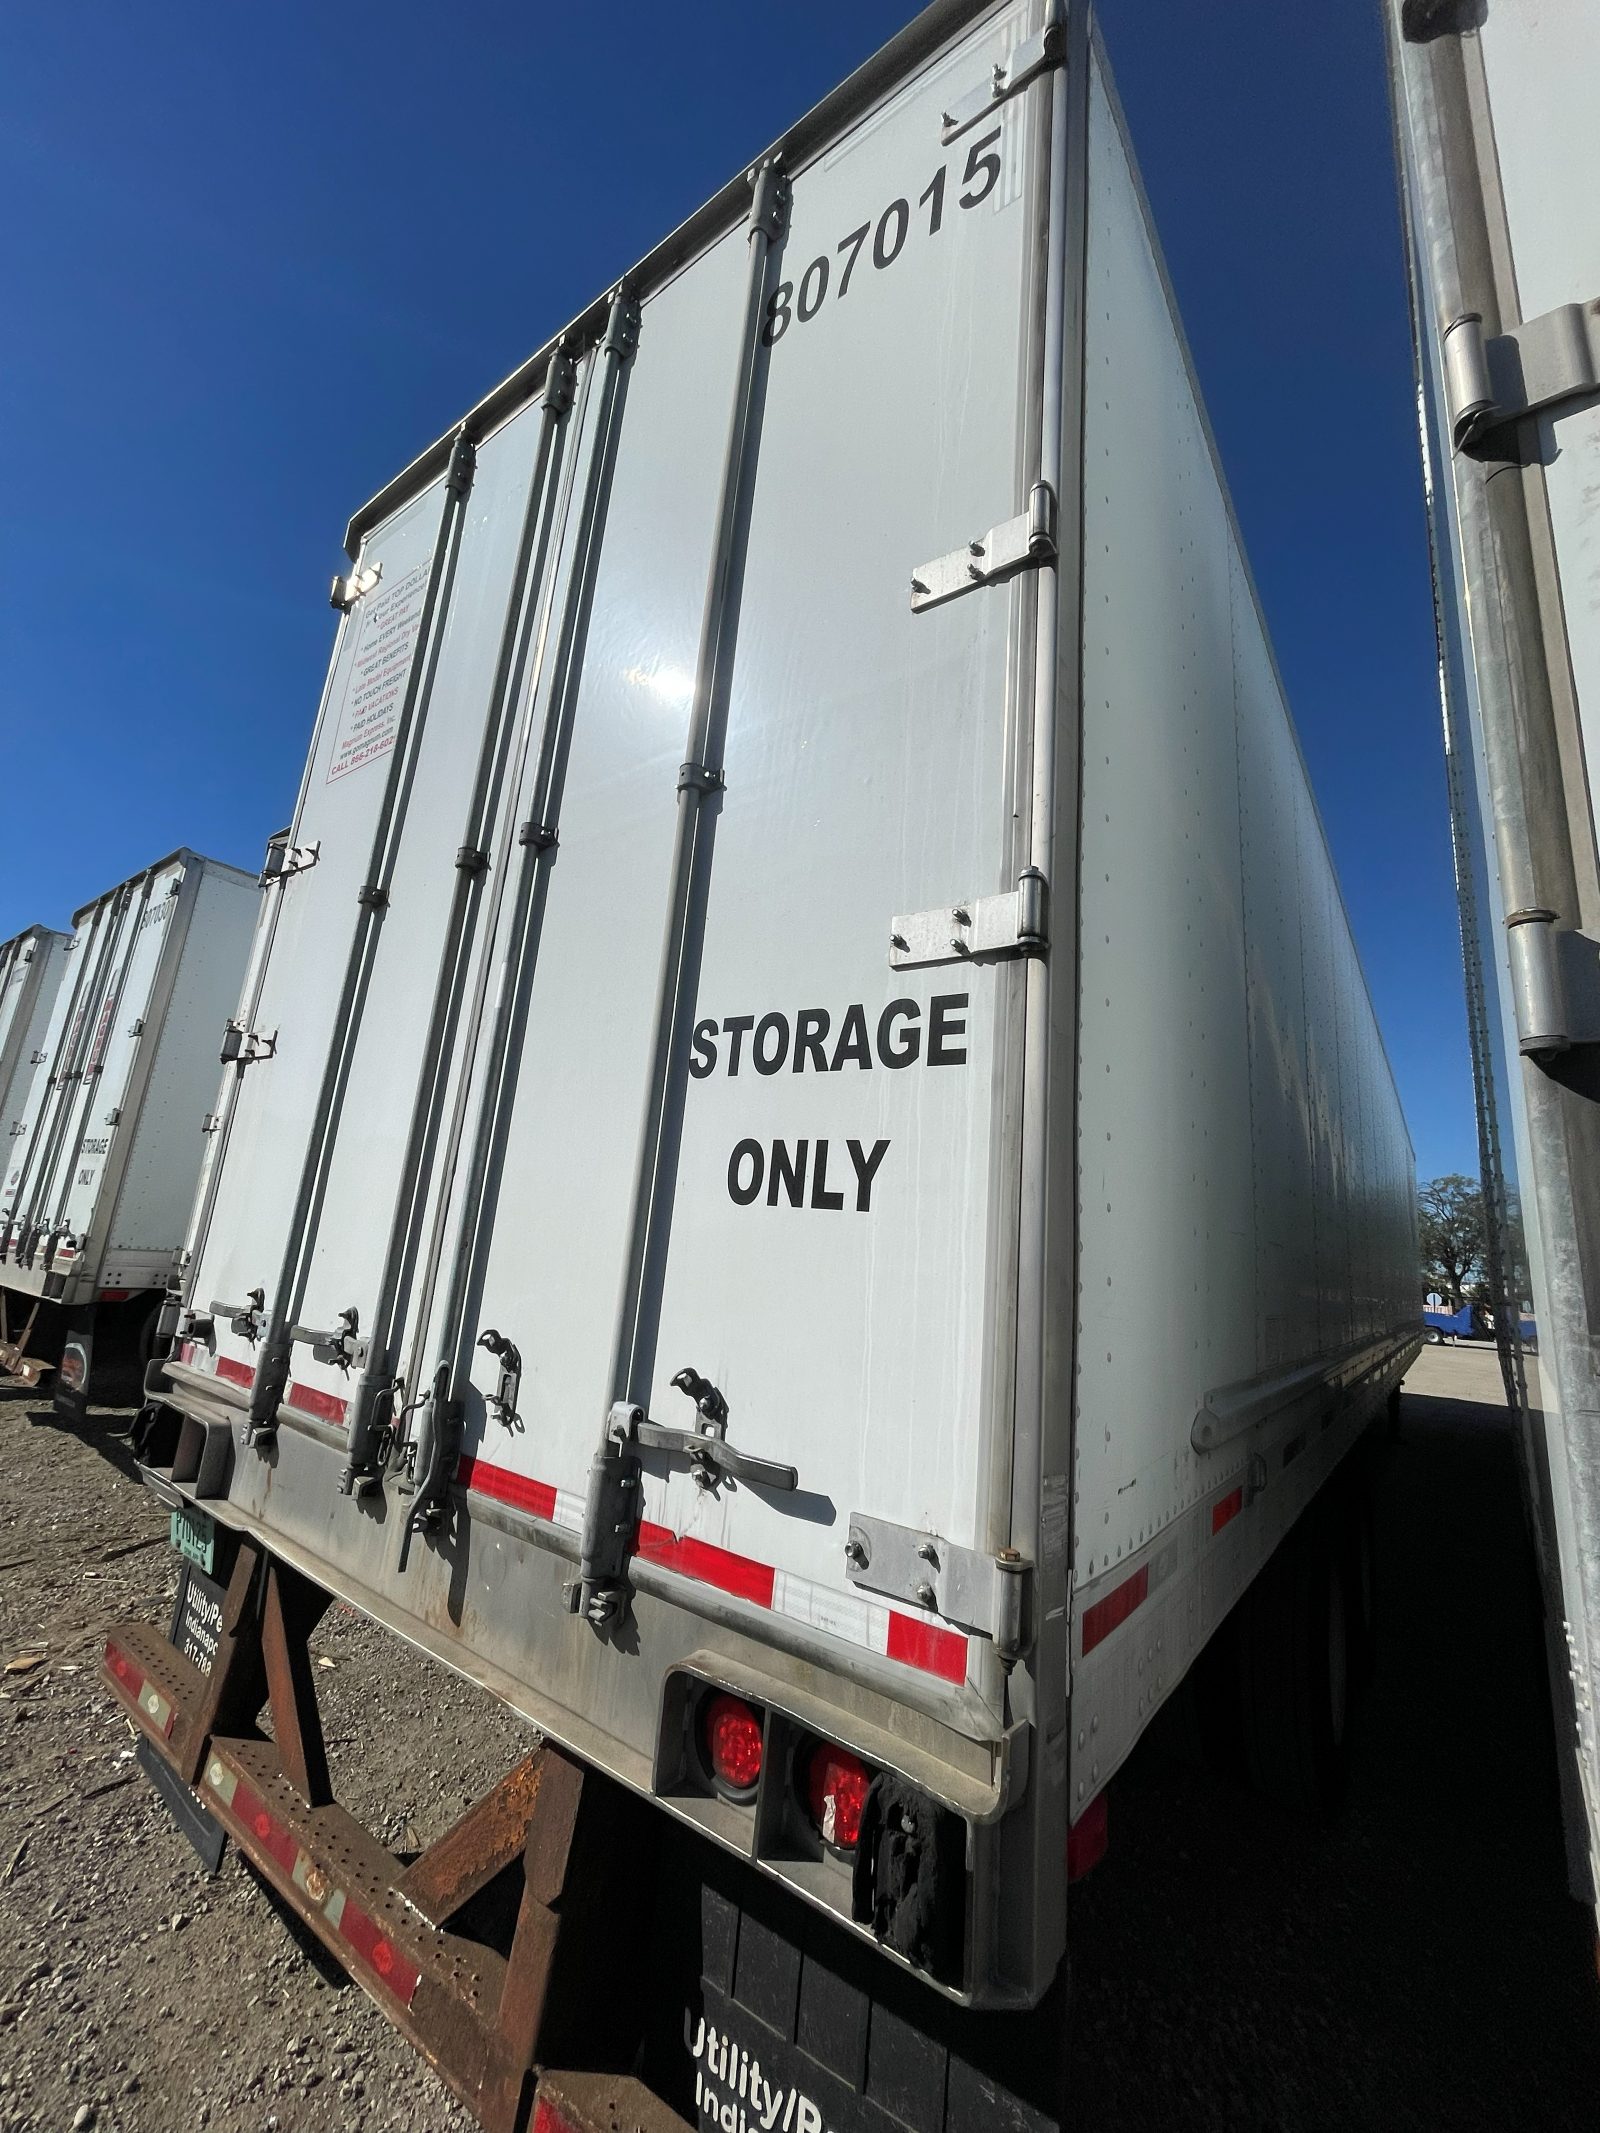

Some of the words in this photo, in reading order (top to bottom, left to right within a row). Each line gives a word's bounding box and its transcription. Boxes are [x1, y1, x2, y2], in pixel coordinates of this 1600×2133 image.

[761, 126, 1002, 348] 807015
[378, 624, 396, 643] EVERY
[362, 658, 381, 677] GREAT
[381, 640, 409, 665] BENEFITS
[353, 694, 362, 707] NO
[362, 683, 381, 702] TOUCH
[381, 668, 406, 690] FREIGHT
[367, 685, 398, 711] VACATIONS
[352, 718, 365, 732] PAID
[366, 701, 394, 724] HOLIDAYS
[330, 758, 349, 776] CALL
[689, 993, 969, 1079] STORAGE
[80, 1139, 108, 1155] STORAGE
[78, 1169, 95, 1186] ONLY
[728, 1138, 891, 1213] ONLY
[184, 1637, 212, 1678] 317-788
[684, 2007, 836, 2133] Utility/P
